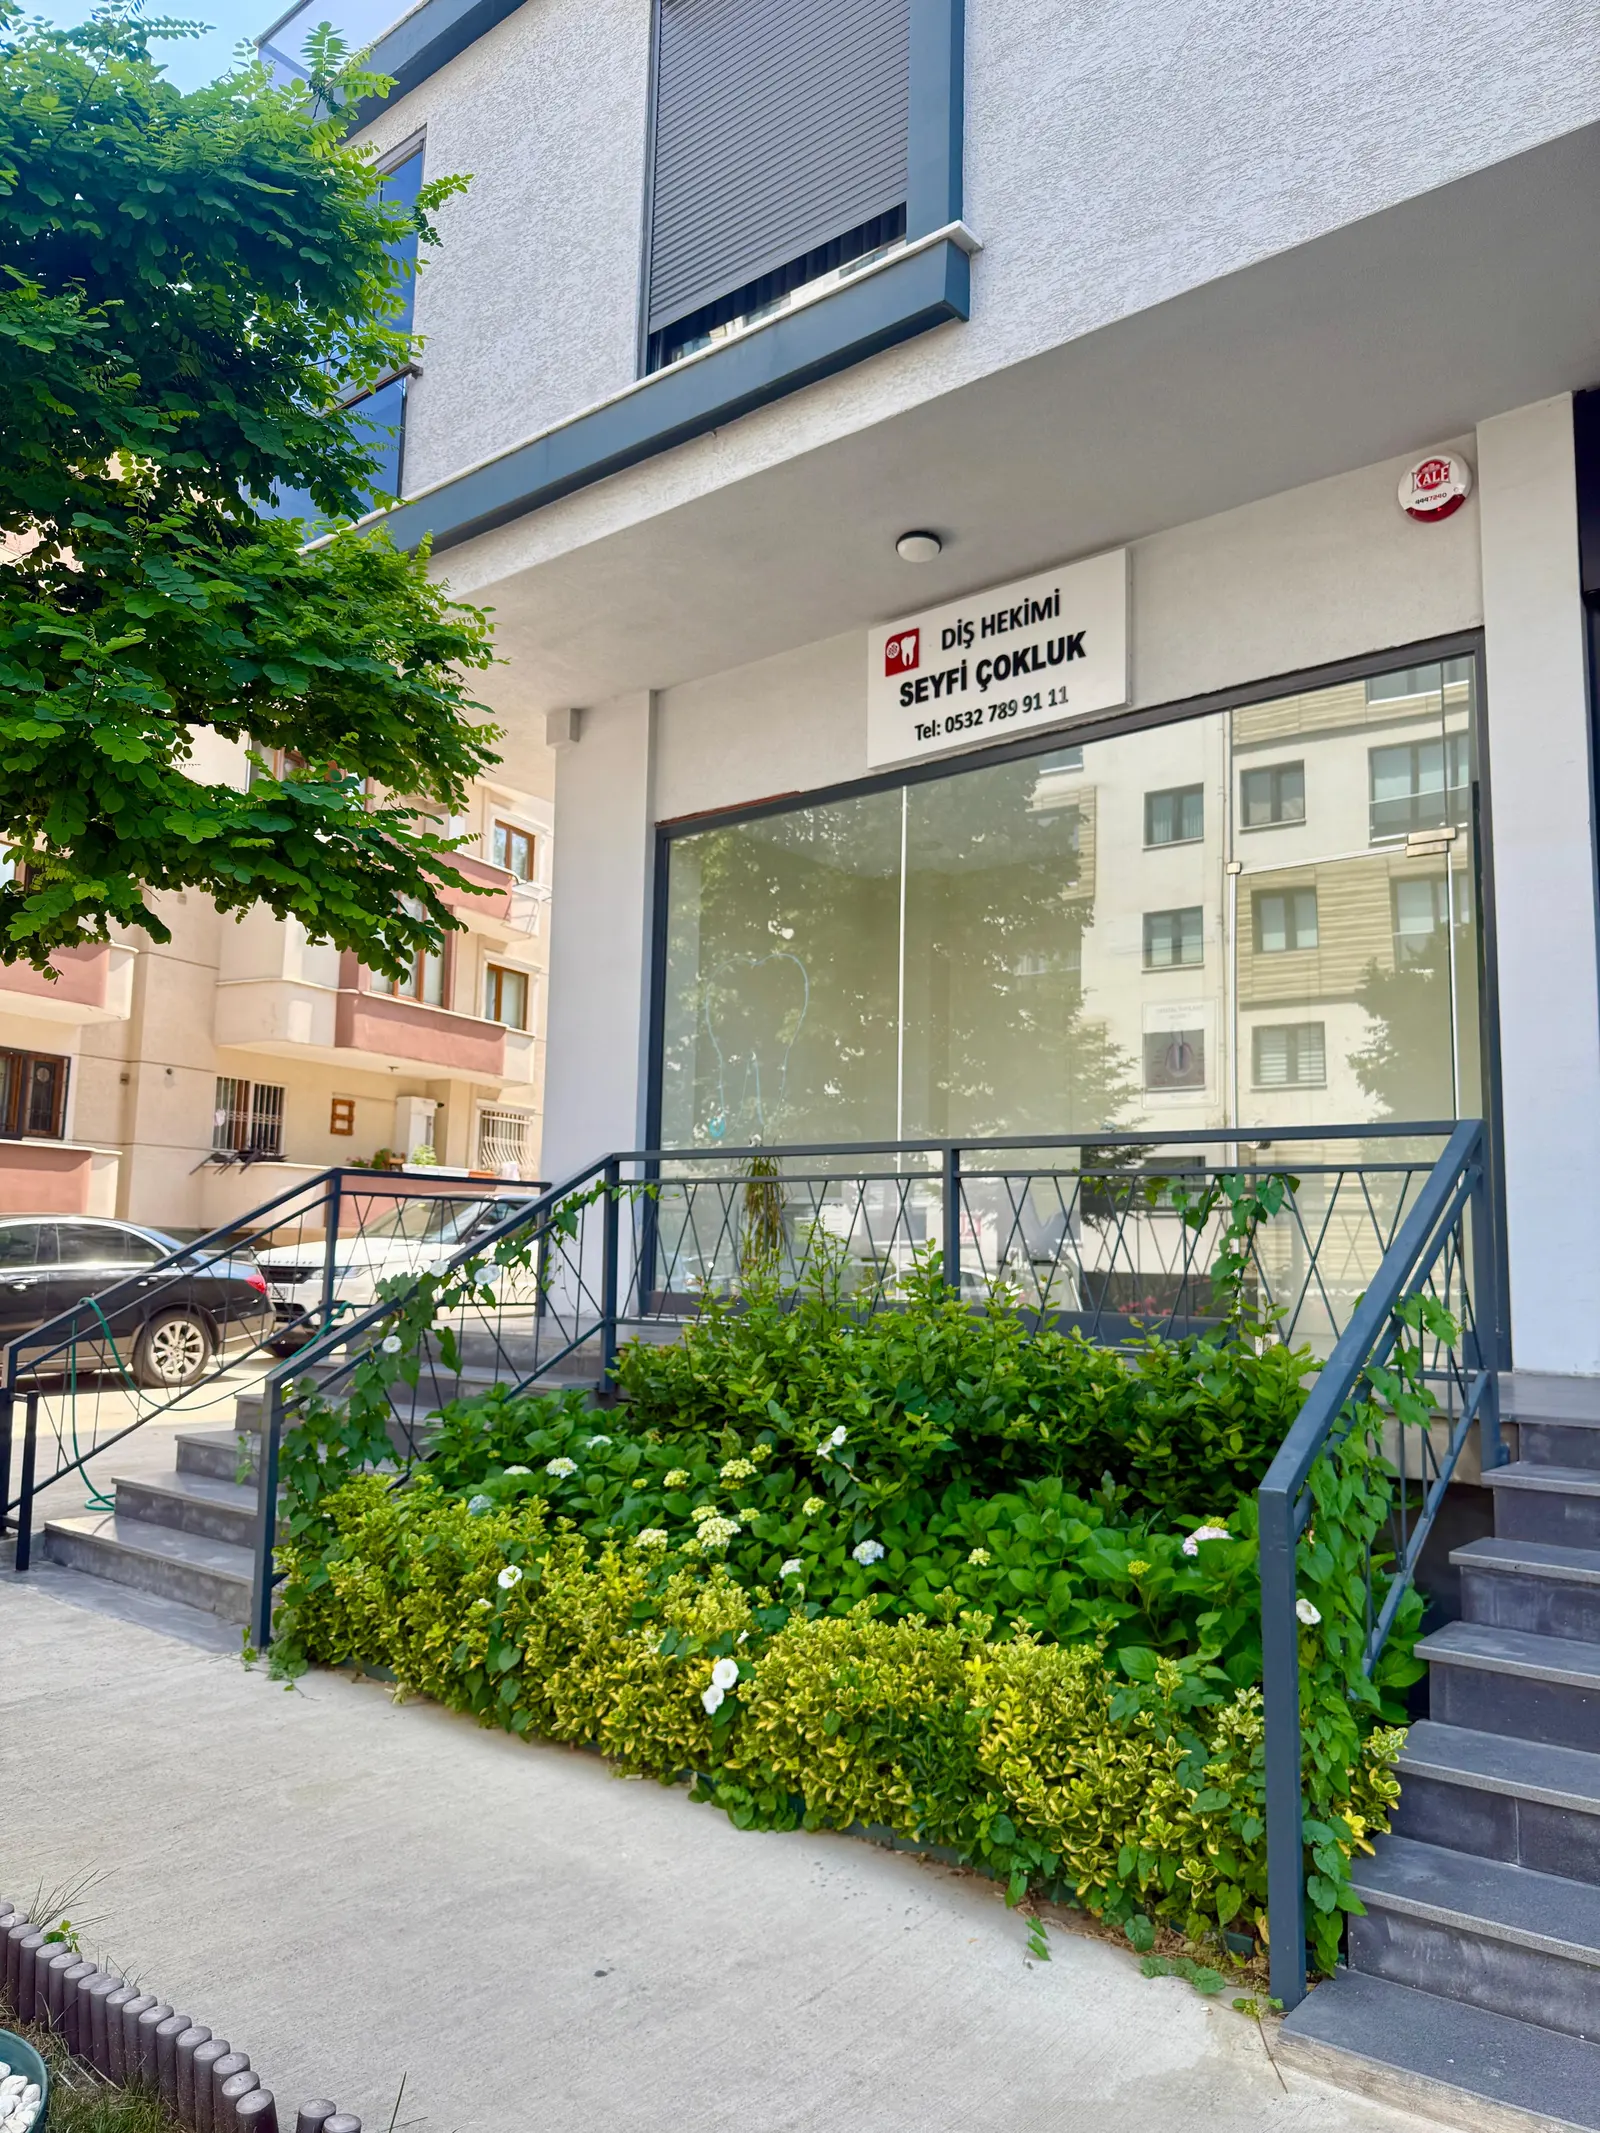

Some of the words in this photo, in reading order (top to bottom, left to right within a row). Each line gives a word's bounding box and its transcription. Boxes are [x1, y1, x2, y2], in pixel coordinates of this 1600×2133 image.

[1413, 464, 1450, 489] KALE
[941, 618, 975, 651] DİŞ
[981, 588, 1061, 639] HEKİMİ
[899, 659, 968, 708] SEYFİ
[975, 630, 1087, 693] ÇOKLUK
[914, 719, 941, 741] Tel:
[945, 708, 983, 734] 0532
[987, 700, 1018, 722] 789
[1022, 692, 1043, 714] 91
[1048, 685, 1069, 707] 11
